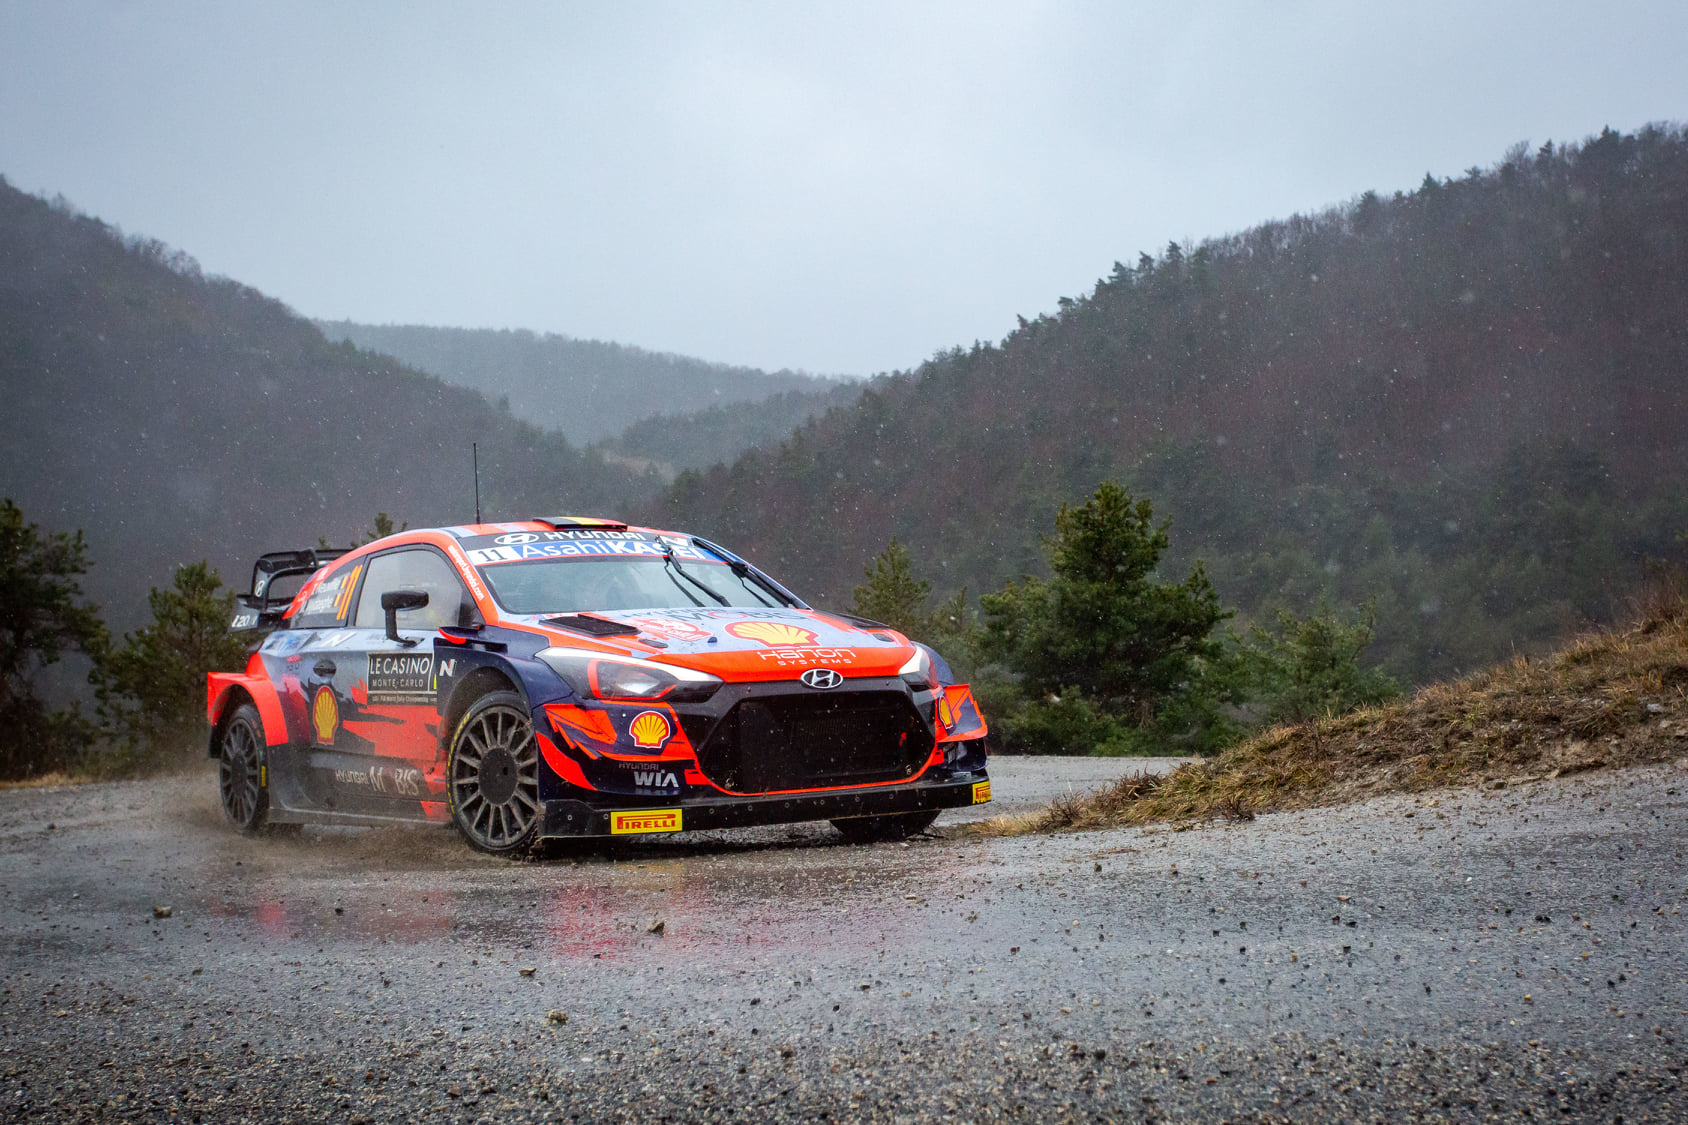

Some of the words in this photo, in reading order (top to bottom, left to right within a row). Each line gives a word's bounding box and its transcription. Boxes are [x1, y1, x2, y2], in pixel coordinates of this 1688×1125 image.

[543, 530, 646, 541] HYUNDAI
[478, 549, 508, 562] 11
[370, 658, 382, 675] LE
[383, 657, 430, 675] CASINO
[777, 658, 852, 666] SYSTEMS
[618, 762, 660, 771] HYUNDAI
[616, 814, 676, 830] PIRELLI
